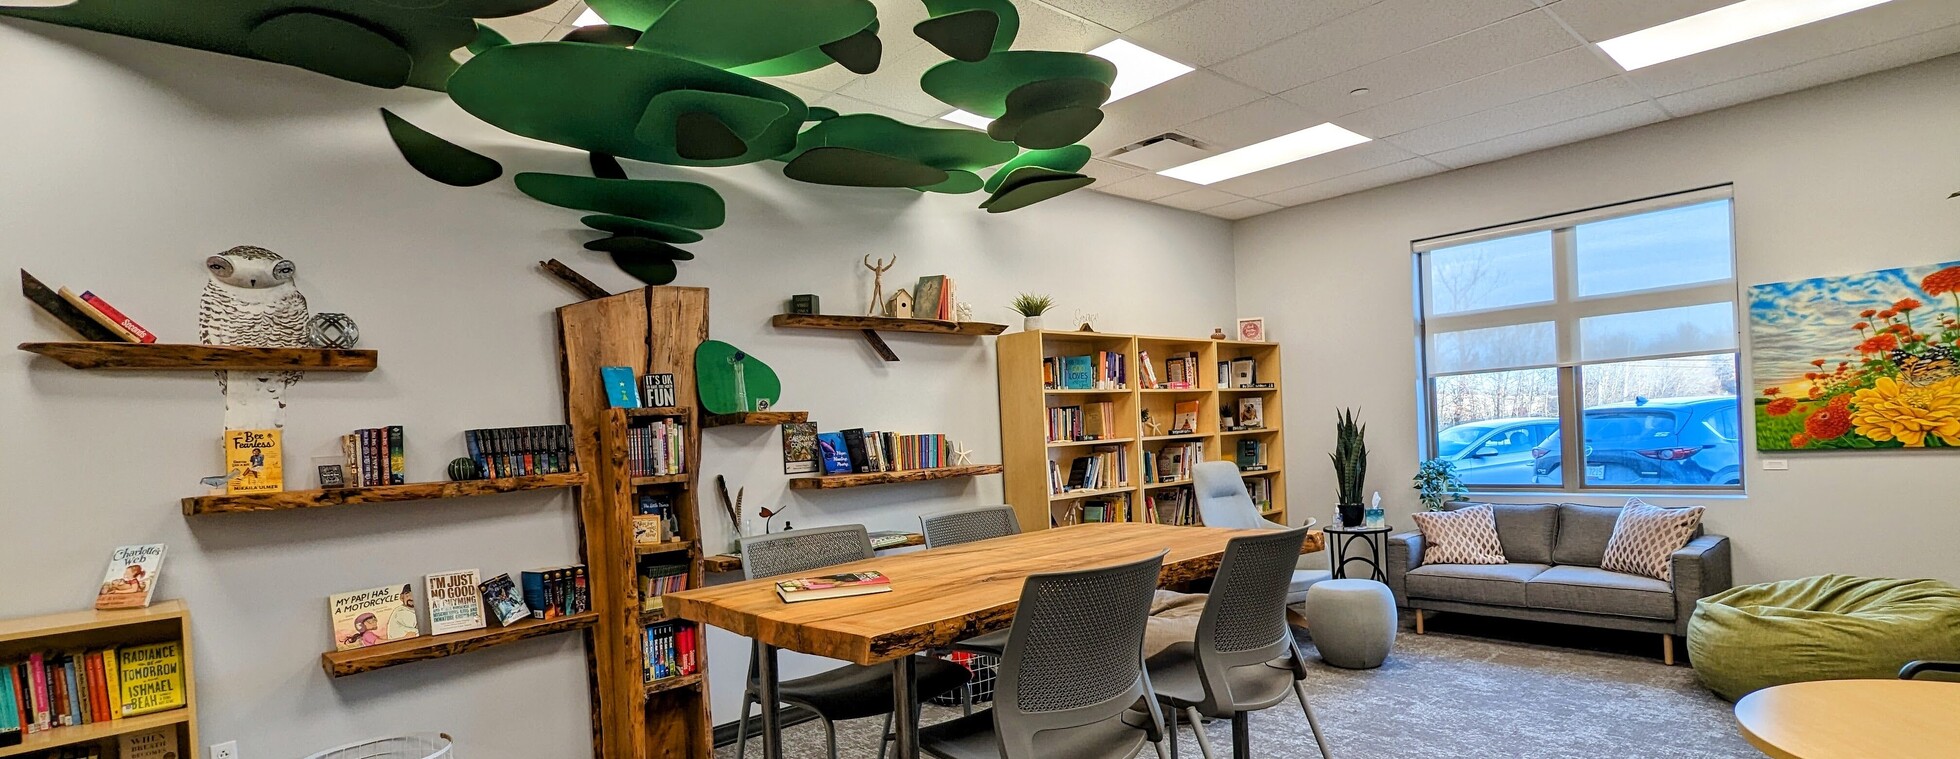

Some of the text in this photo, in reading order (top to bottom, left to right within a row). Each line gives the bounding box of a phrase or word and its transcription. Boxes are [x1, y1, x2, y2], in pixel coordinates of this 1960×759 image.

[646, 375, 673, 385] IT'S OK
[648, 389, 675, 406] FUN
[233, 437, 275, 449] Fearless
[244, 431, 264, 443] Bee
[113, 546, 161, 561] Charlotte's
[125, 556, 146, 566] Web
[430, 573, 474, 589] I'M JUST
[336, 588, 389, 607] MY PAPI HAS
[431, 588, 445, 599] NO
[447, 586, 475, 598] GOOD
[335, 594, 399, 615] A MOTORCYCLE
[123, 646, 175, 664] RADIANCE
[123, 663, 177, 682] TOMORROW
[128, 679, 173, 698] ISHMAEL
[132, 694, 158, 710] BEAH
[130, 735, 166, 745] WHEN
